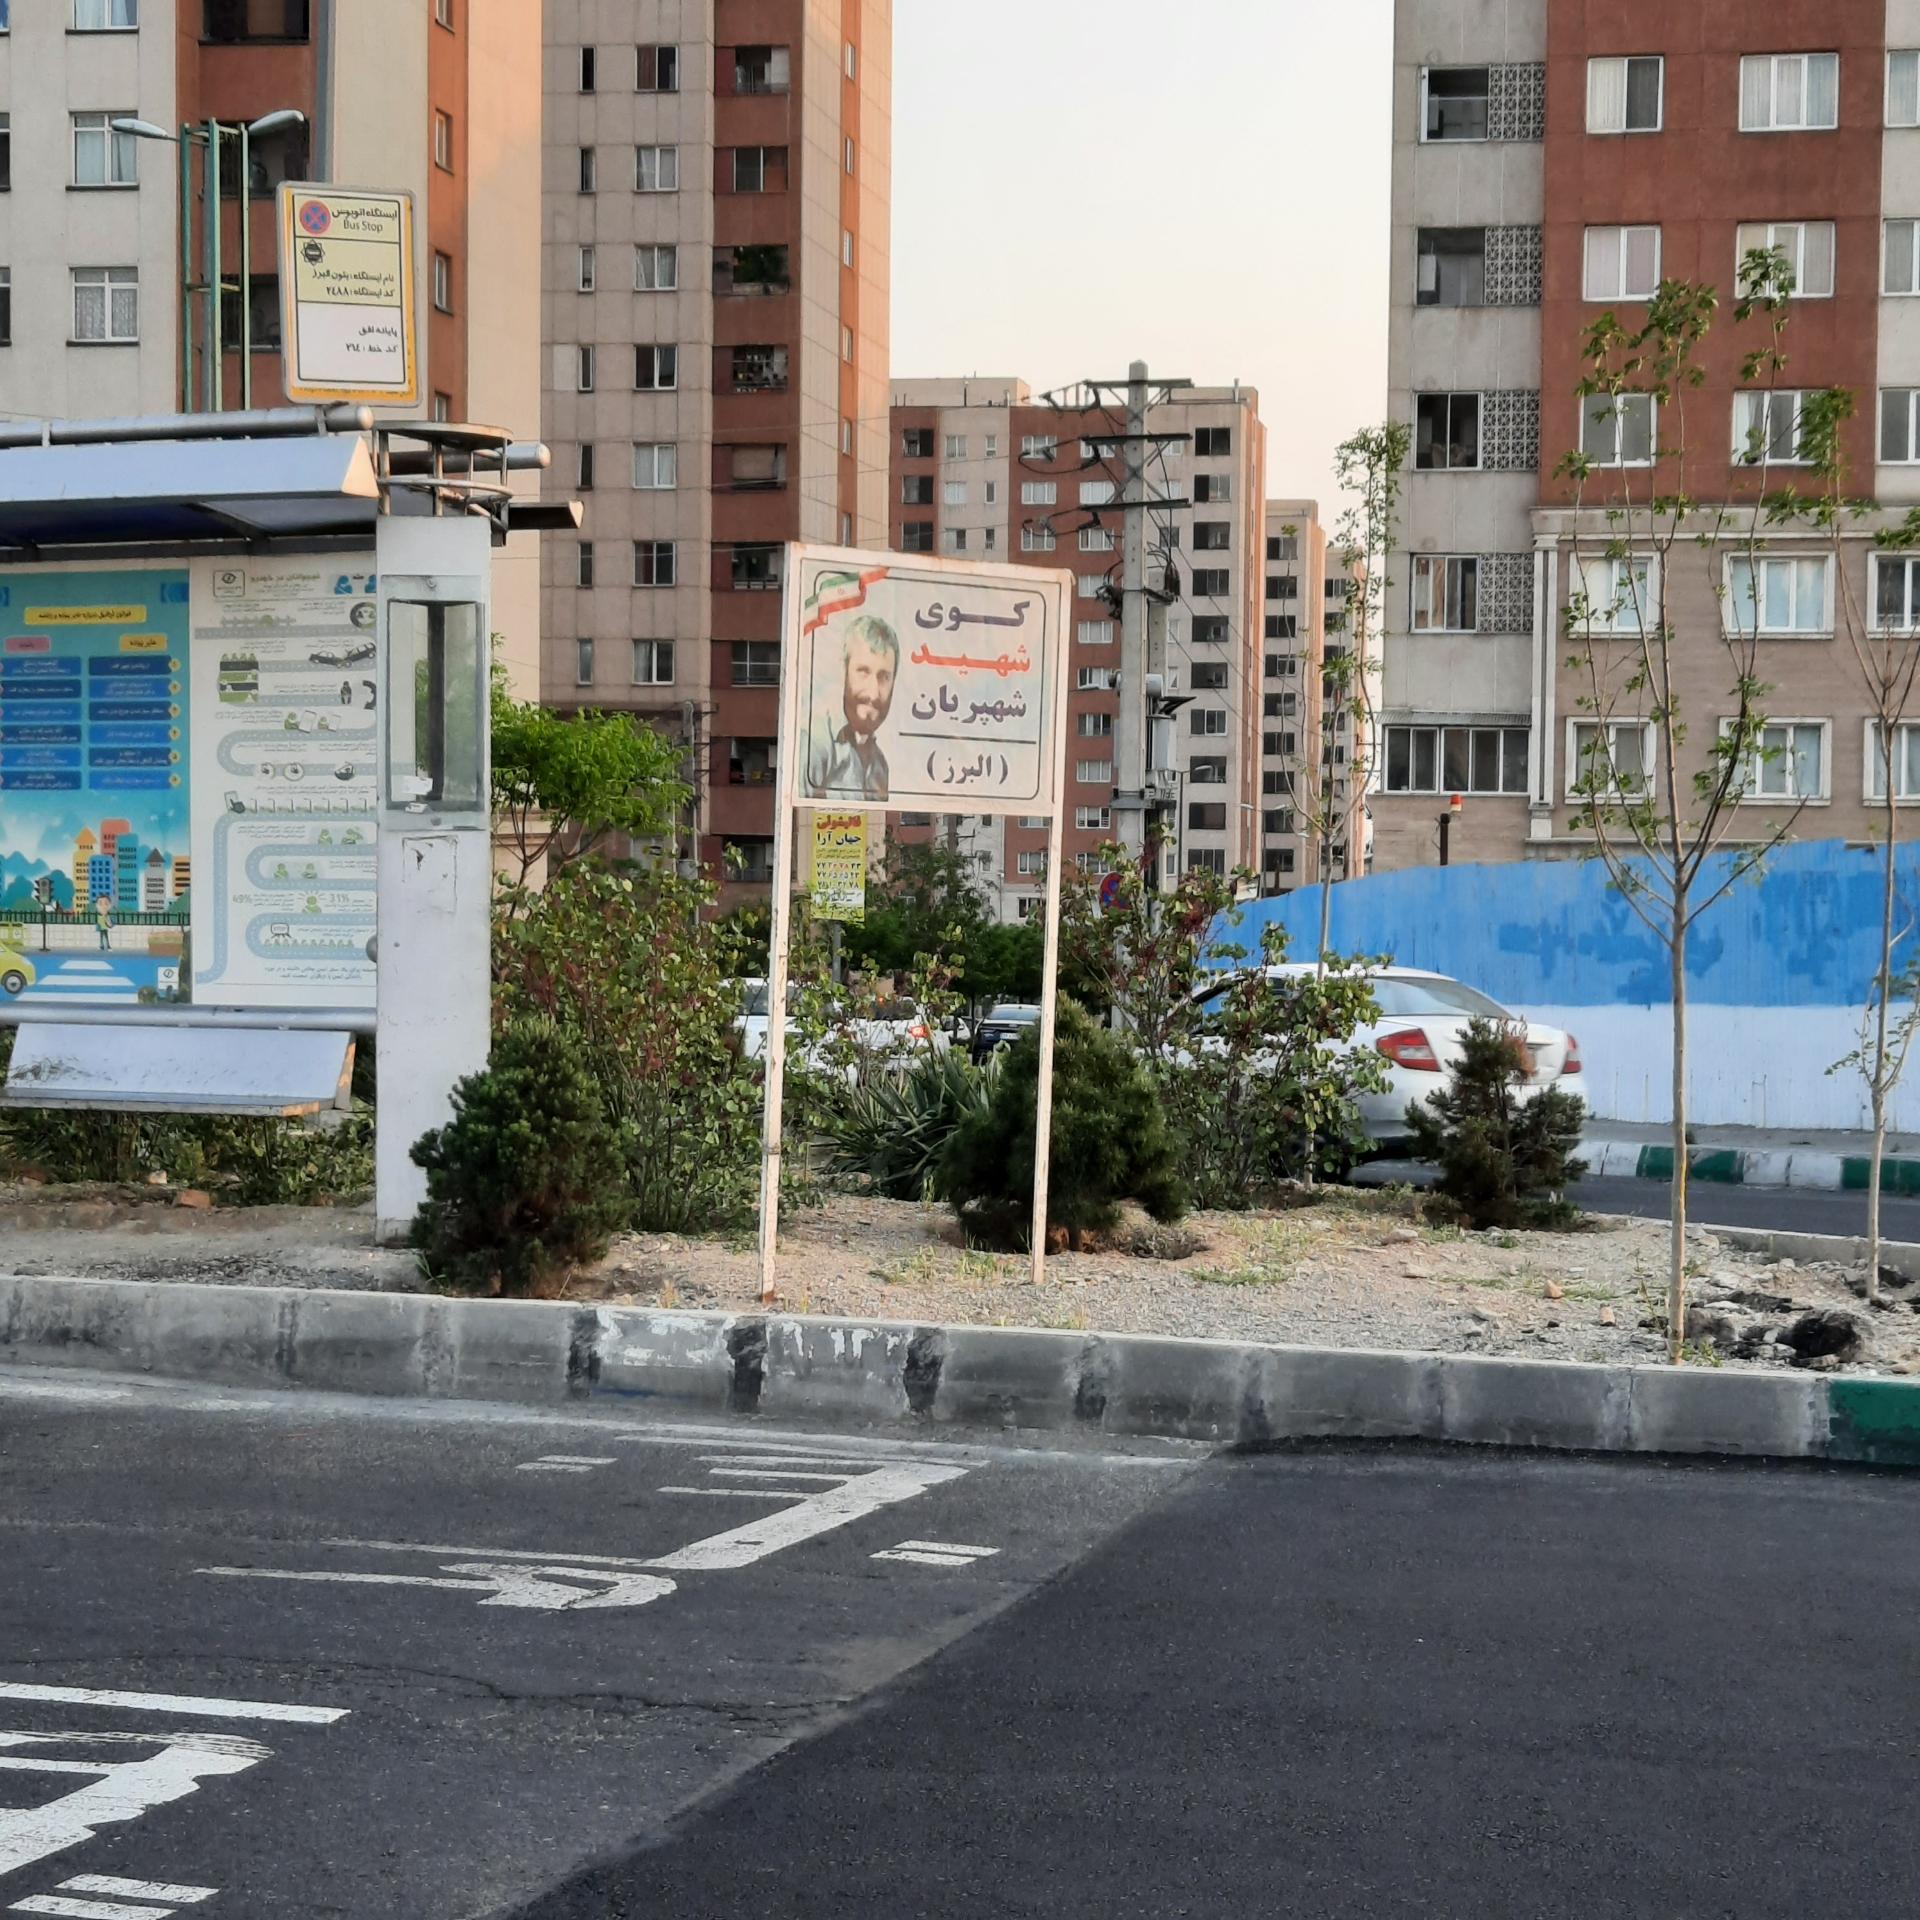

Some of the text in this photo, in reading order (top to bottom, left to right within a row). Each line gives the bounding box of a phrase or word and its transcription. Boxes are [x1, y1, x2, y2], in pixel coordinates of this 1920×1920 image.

[332, 207, 397, 221] ایستگاه اتوبوس
[343, 219, 383, 233] Bus Stop
[382, 274, 395, 285] نام
[383, 288, 396, 297] کد
[914, 600, 1031, 631] کوی
[910, 643, 1031, 677] شهید
[911, 684, 1027, 725] شهپریان
[817, 830, 833, 846] آرا
